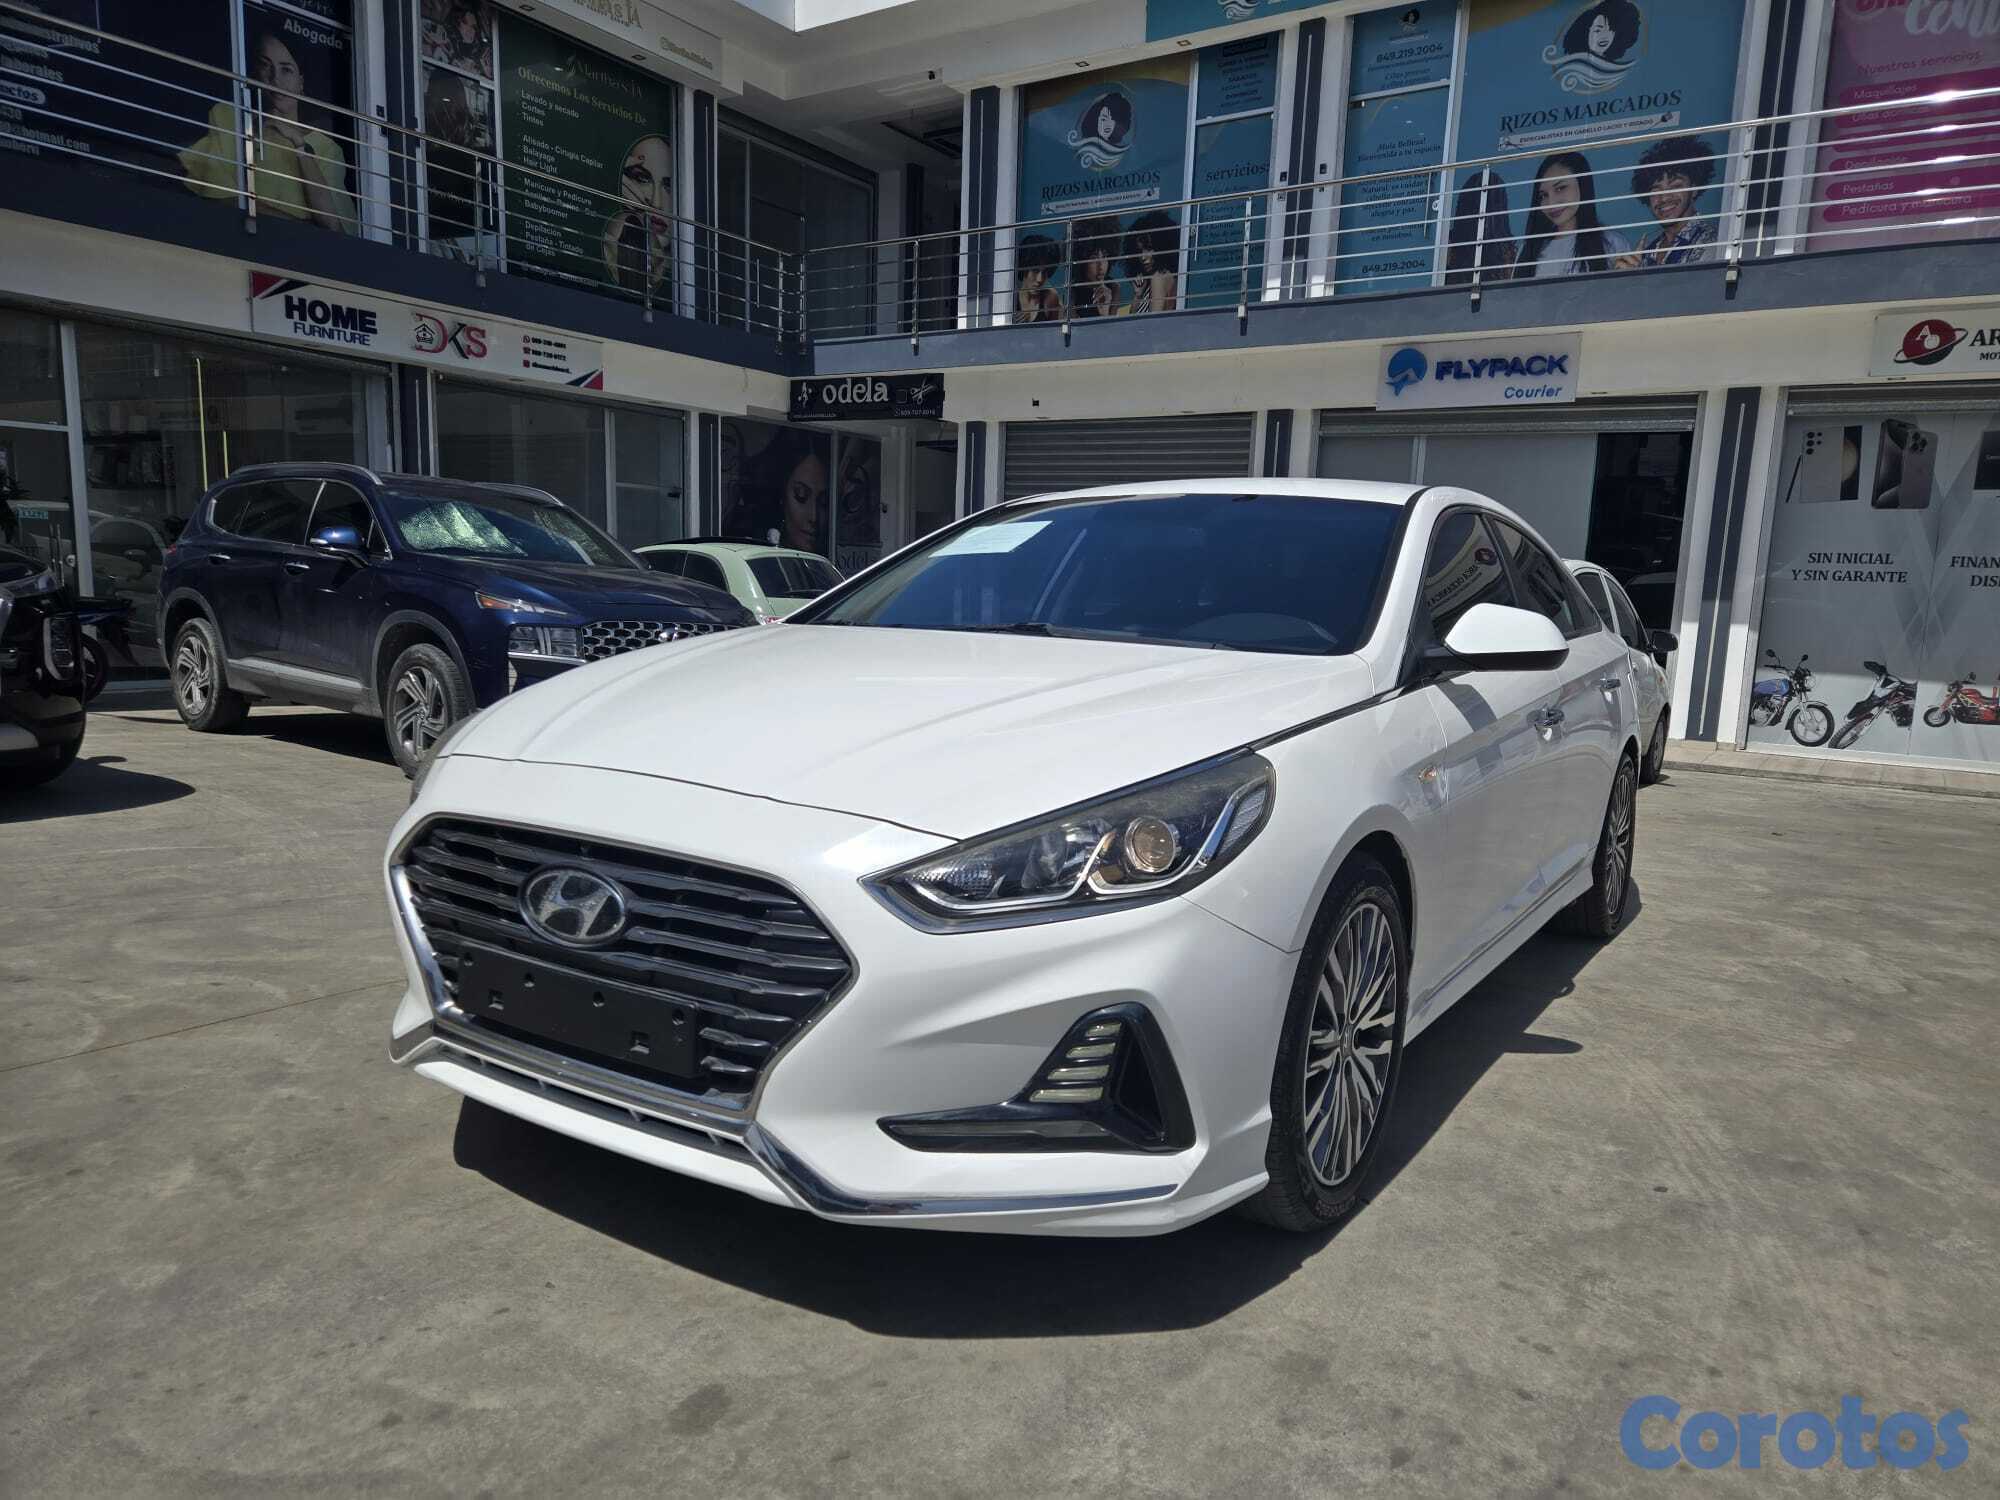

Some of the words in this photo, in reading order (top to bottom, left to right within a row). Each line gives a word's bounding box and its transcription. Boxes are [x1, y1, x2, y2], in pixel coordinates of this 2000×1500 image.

[1500, 108, 1559, 133] RIZOS
[1561, 88, 1682, 123] MARCADOS
[1041, 179, 1082, 201] RIZOS
[1082, 169, 1160, 194] MARCADOS
[285, 295, 378, 334] HOME
[294, 322, 371, 346] FURNITURE
[1435, 354, 1569, 381] FLYPACK
[822, 376, 889, 404] odela
[1504, 384, 1563, 400] Courier
[1808, 552, 1833, 565] SIN
[1835, 552, 1895, 566] INICIAL
[1792, 569, 1806, 582] Y
[1807, 570, 1830, 583] SIN
[1832, 570, 1909, 585] GARANTE
[1970, 574, 2000, 588] DIS
